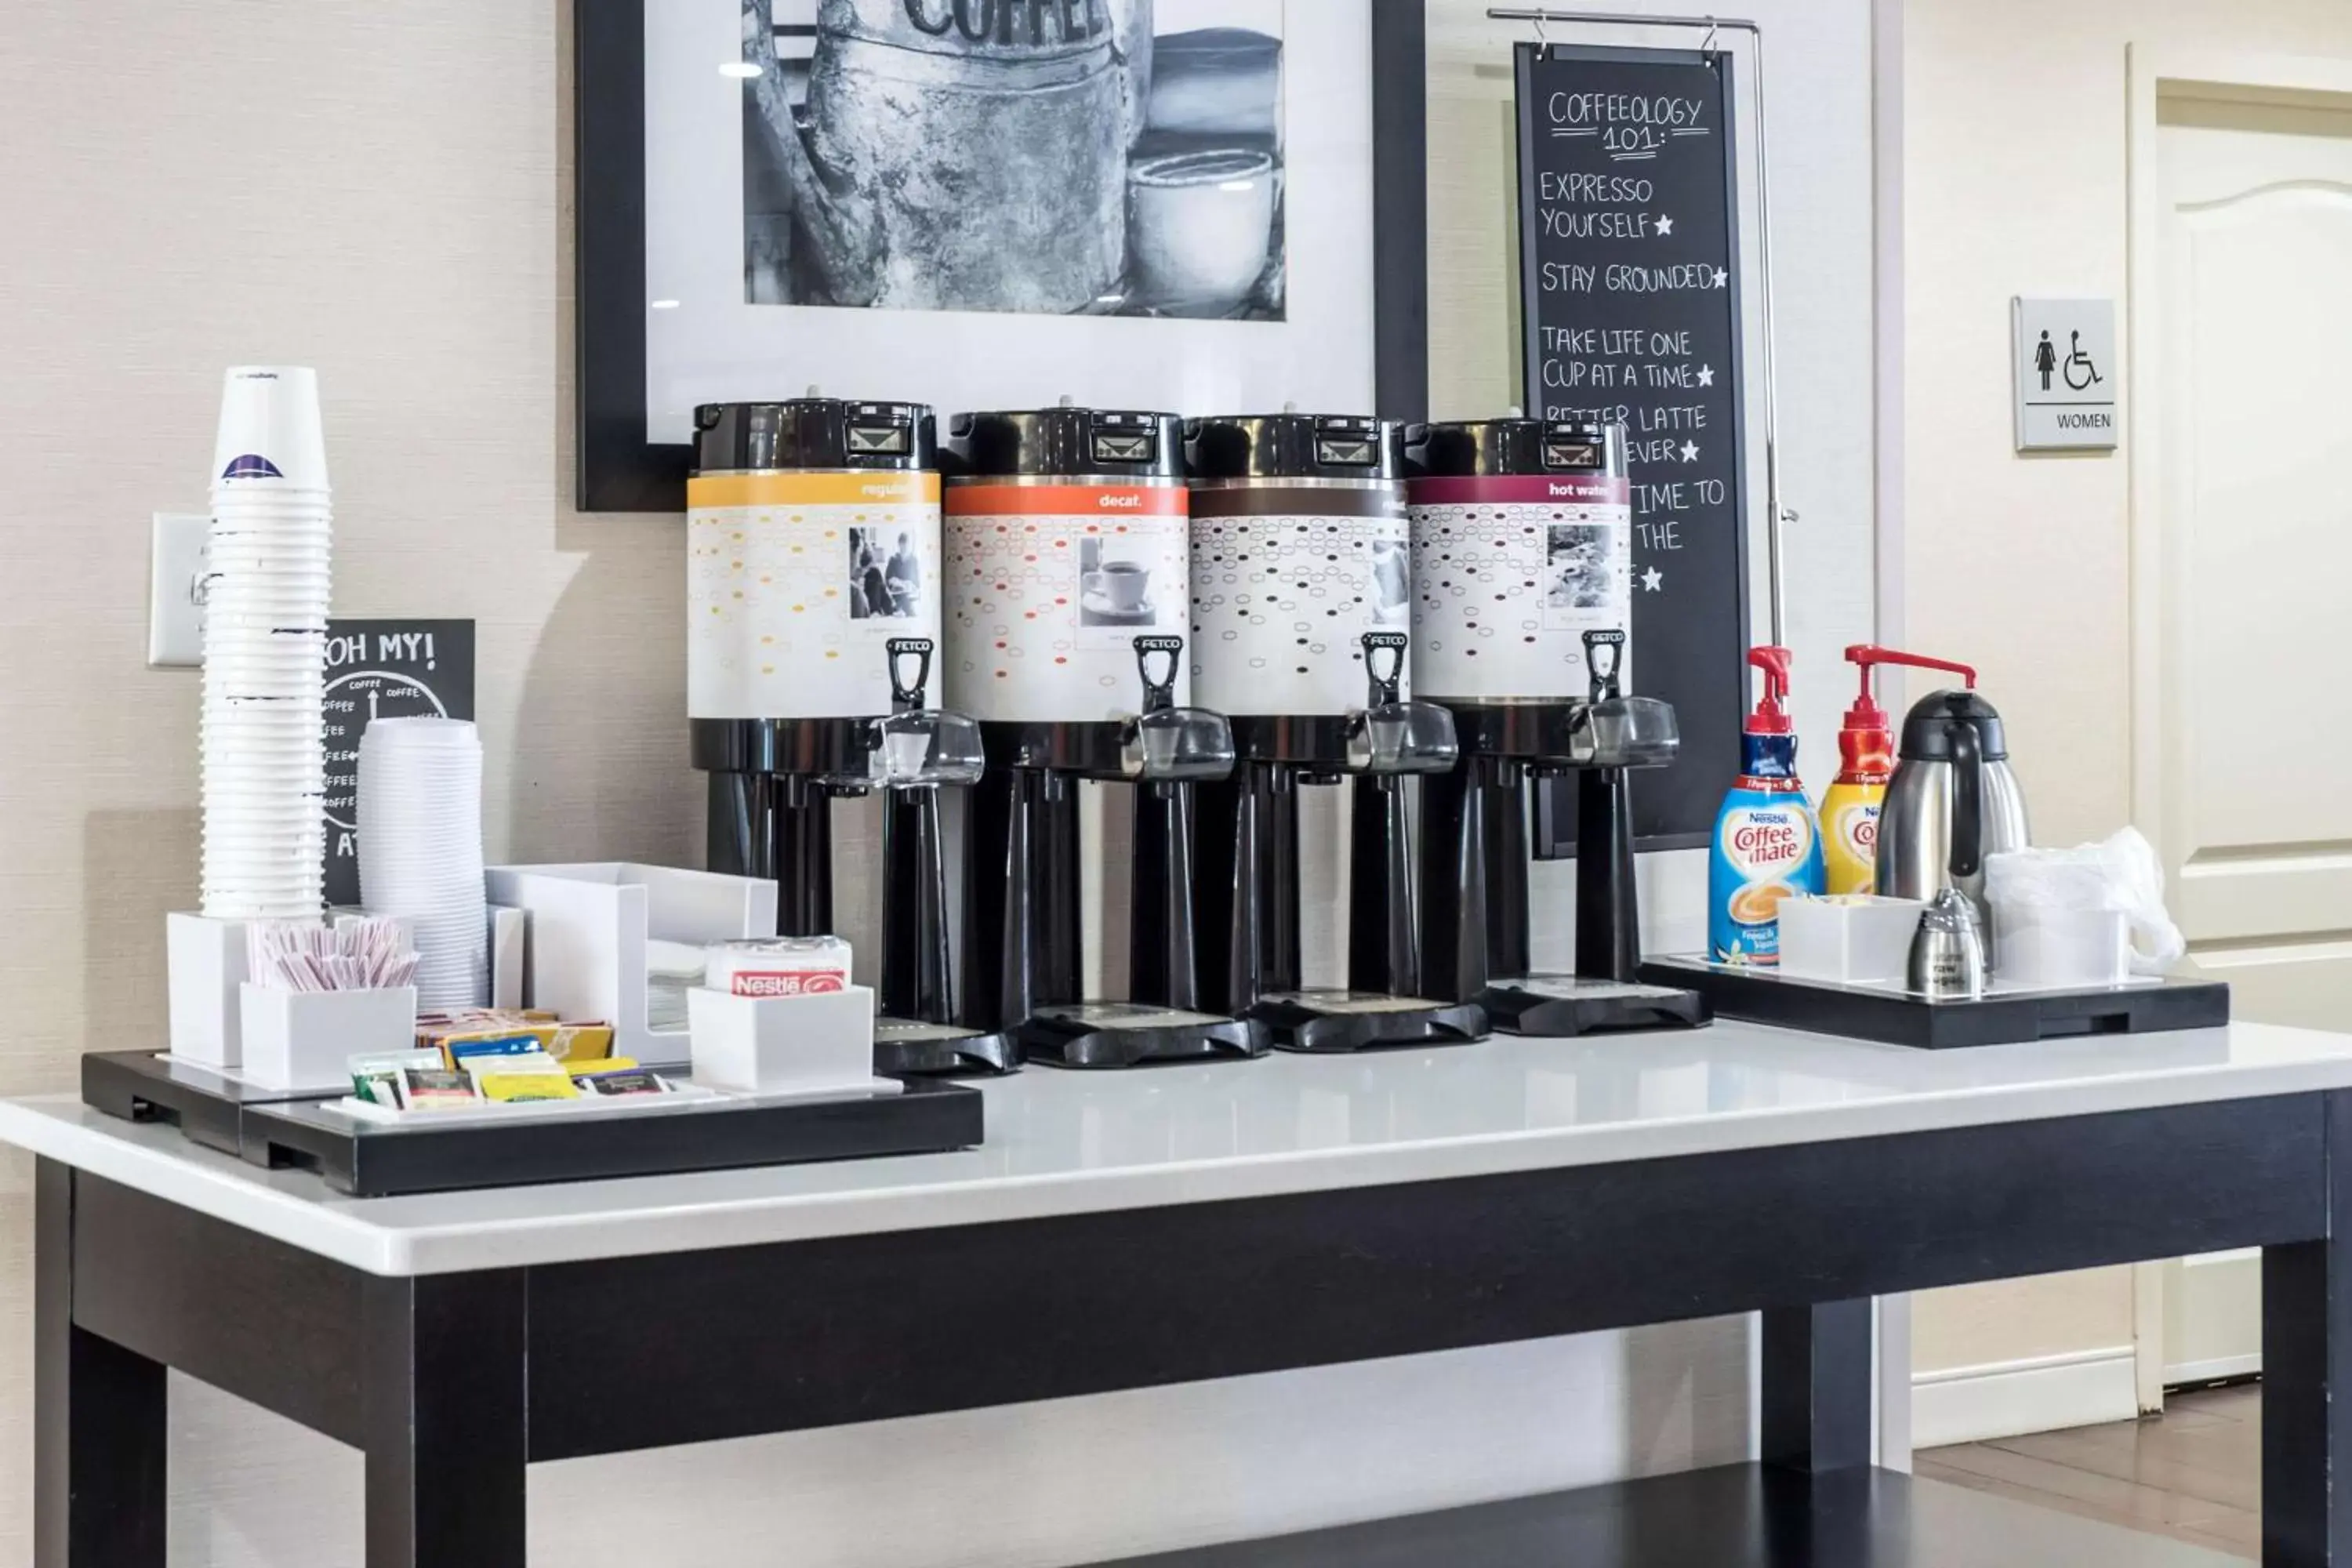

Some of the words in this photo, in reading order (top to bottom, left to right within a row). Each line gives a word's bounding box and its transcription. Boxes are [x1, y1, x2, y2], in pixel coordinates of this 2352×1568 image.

[1548, 92, 1702, 126] COFFEEOLOGY
[1602, 127, 1667, 151] 101:
[1541, 172, 1653, 202] EXPRESSO
[1542, 262, 1595, 292] STAY
[1606, 264, 1714, 292] GROUNDED
[1541, 326, 1596, 354] TAKE
[1602, 330, 1644, 354] LIFE
[1650, 332, 1693, 357] ONE
[1543, 359, 1586, 387] CUP
[1592, 364, 1617, 387] AT
[1624, 365, 1637, 387] A
[1639, 405, 1708, 432] LATTE
[2056, 413, 2111, 428] WOMEN
[1549, 482, 1574, 496] hot
[1693, 479, 1725, 505] TO
[1635, 521, 1683, 550] THE
[895, 640, 931, 652] FETCO
[1142, 639, 1180, 648] FETCO
[1370, 635, 1406, 645] FETCO
[349, 679, 381, 690] COFFEE
[387, 688, 421, 698] COFFEE
[735, 975, 800, 995] Nestlé
